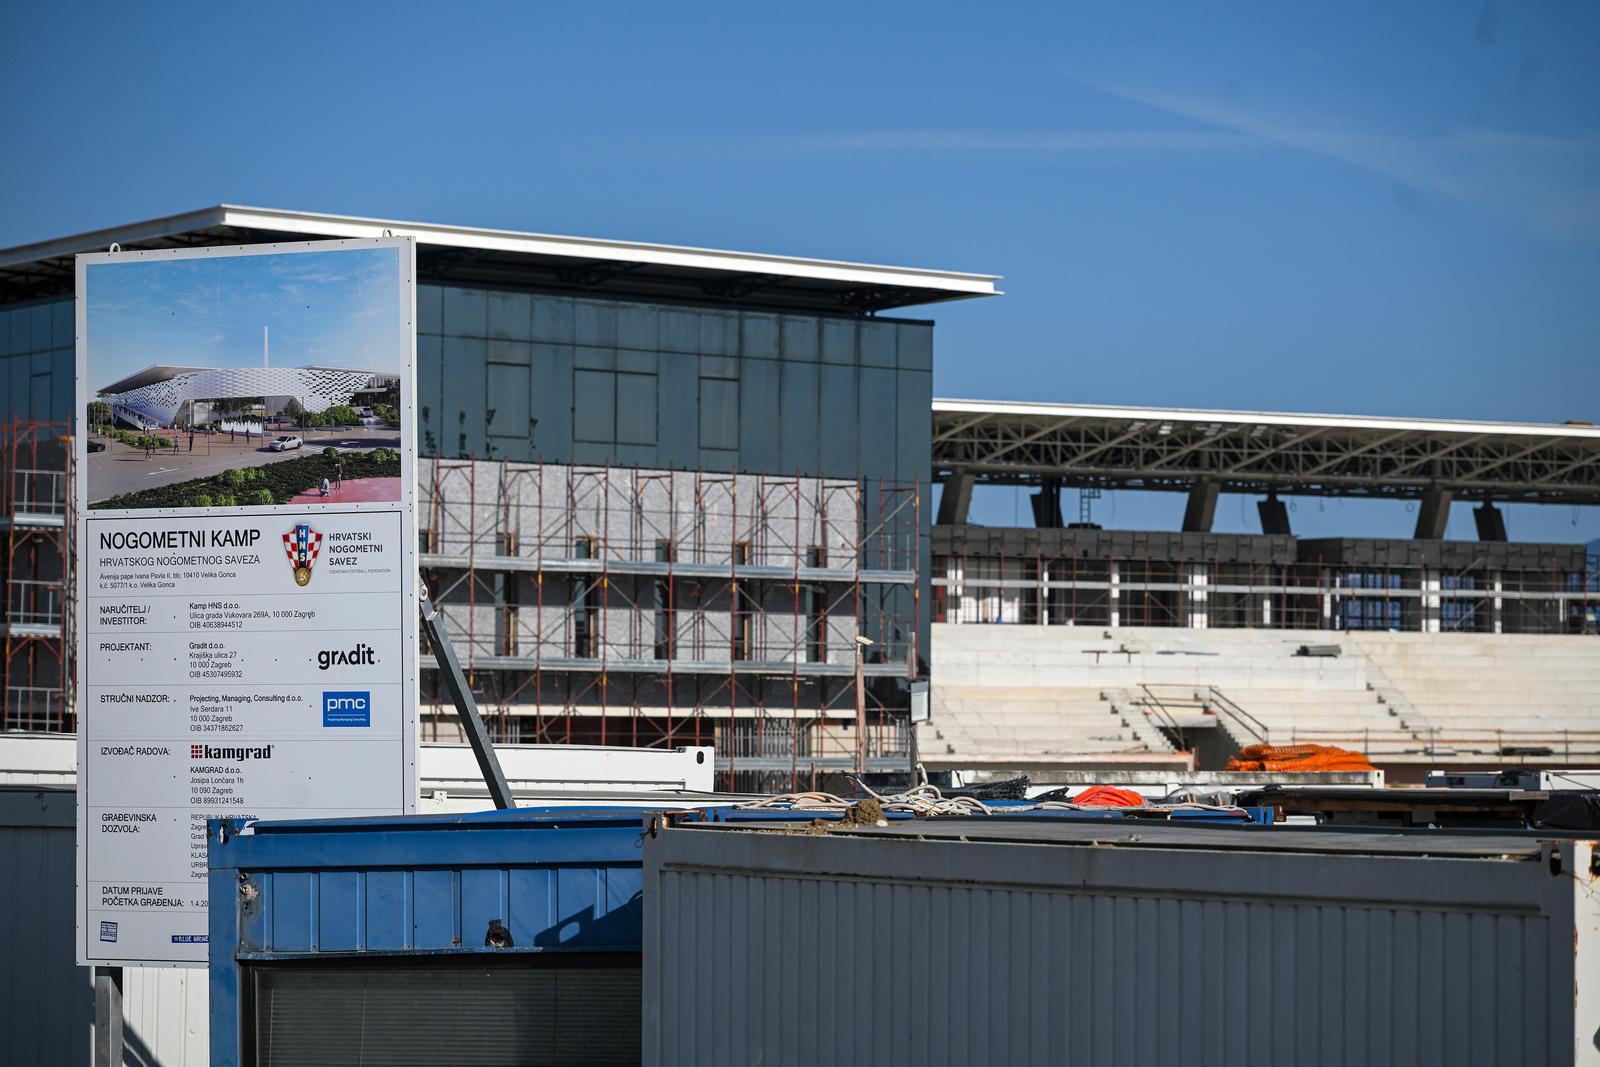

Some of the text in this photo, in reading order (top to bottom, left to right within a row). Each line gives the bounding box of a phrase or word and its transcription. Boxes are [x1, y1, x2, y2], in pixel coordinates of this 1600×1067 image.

[100, 529, 261, 550] NOGOMETNI KAMP
[329, 532, 372, 542] HRVATSKI
[329, 544, 383, 554] NOGOMETNI
[100, 555, 260, 567] HRVATSKOG NOGOMETNOG SAVEZA
[329, 557, 357, 566] SAVEZ
[100, 604, 146, 615] NARUČITELJ
[206, 612, 222, 620] grada
[254, 611, 270, 619] 269A,
[294, 611, 315, 619] Zagreb
[100, 617, 147, 626] INVESTITOR:
[100, 643, 152, 652] PROJEKTANT:
[318, 644, 374, 670] gradit
[211, 661, 232, 669] Zagreb
[100, 693, 170, 703] STRUČNI NADZOR:
[190, 695, 220, 703] Projecting,
[222, 695, 253, 703] Managing,
[254, 694, 285, 703] Consulting
[327, 698, 366, 712] pmc
[211, 715, 232, 723] Zagreb
[101, 746, 170, 756] IZVOĐAČ RADOVA:
[205, 745, 271, 761] kamgrad
[212, 787, 233, 795] Zagreb
[102, 813, 157, 822] GRAĐEVINSKA
[102, 825, 140, 833] DOZVOLA:
[131, 887, 163, 895] PRIJAVE
[102, 897, 139, 906] POČETKA
[140, 898, 184, 907] GRAĐENJA:
